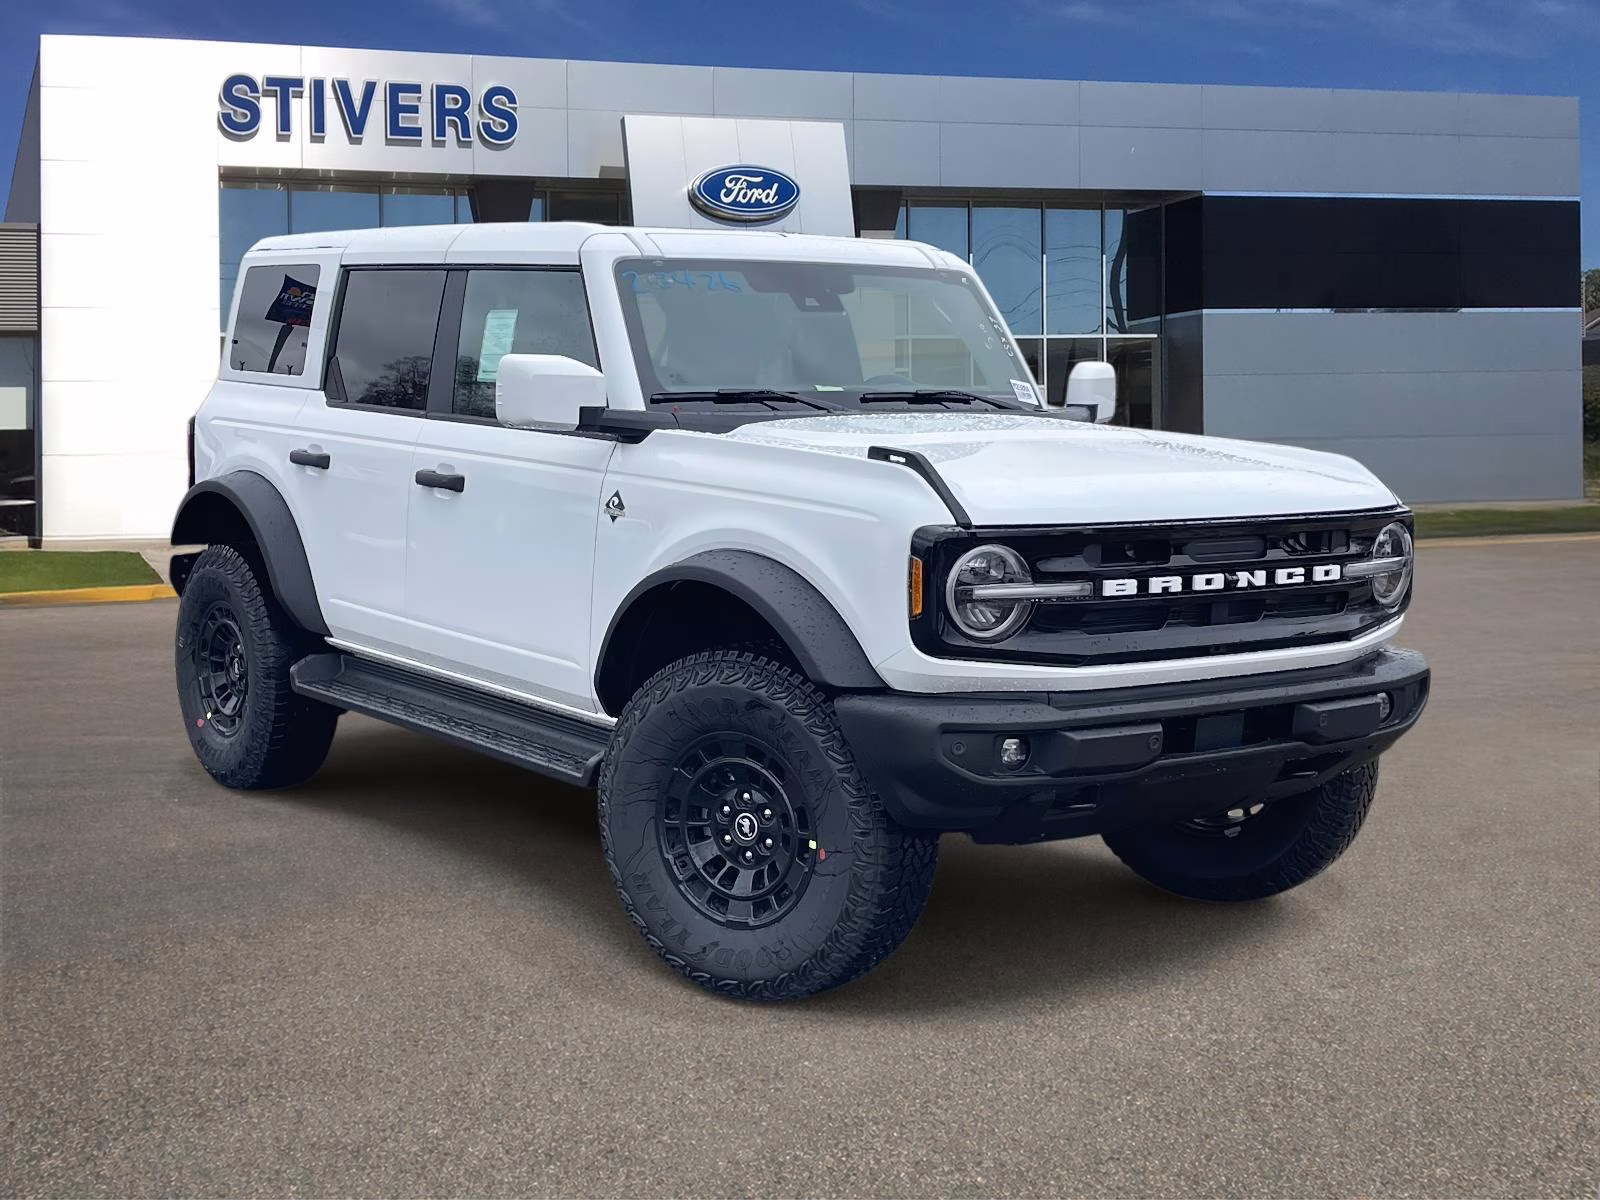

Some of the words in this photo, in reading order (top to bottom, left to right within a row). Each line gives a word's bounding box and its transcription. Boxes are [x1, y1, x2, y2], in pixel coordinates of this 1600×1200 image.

[218, 72, 519, 145] STIVERS
[720, 174, 779, 204] Ford
[1102, 564, 1341, 597] BRONCO
